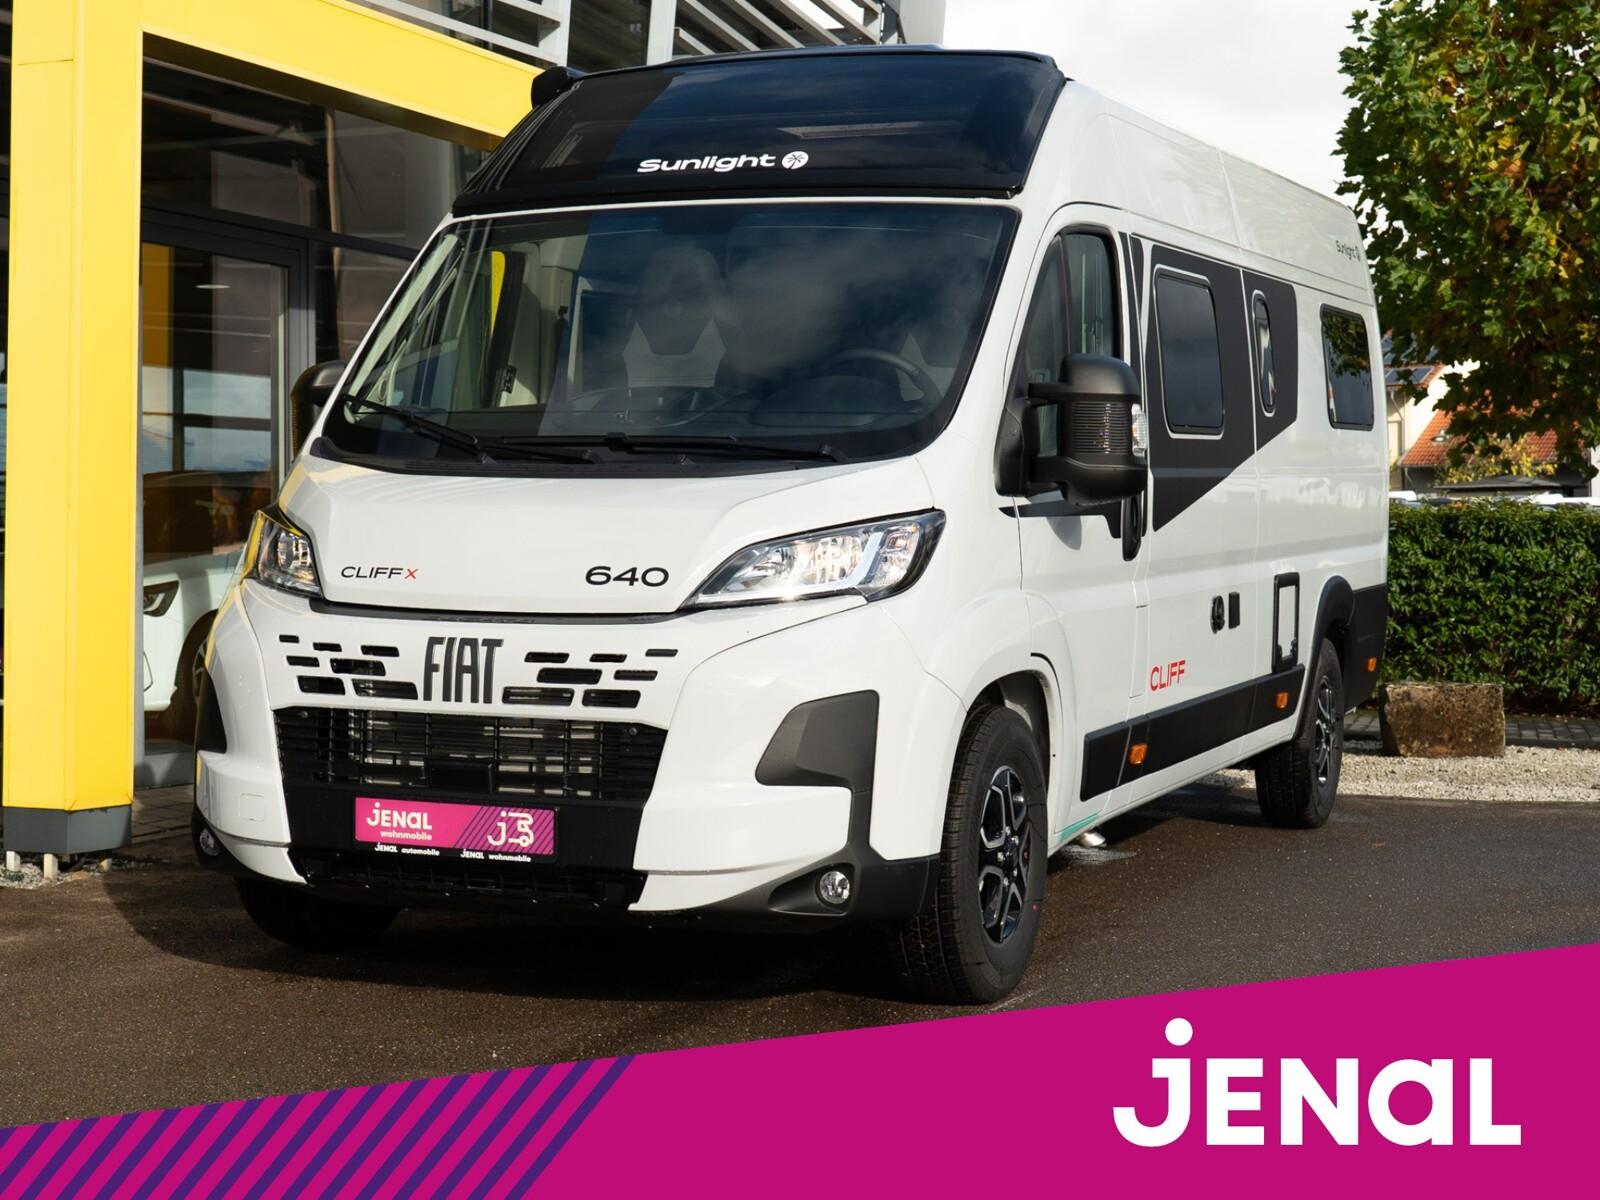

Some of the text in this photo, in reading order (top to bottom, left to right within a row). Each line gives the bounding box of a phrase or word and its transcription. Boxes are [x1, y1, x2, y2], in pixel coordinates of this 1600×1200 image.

[637, 153, 776, 173] Sunlight
[585, 566, 669, 587] 640
[423, 637, 504, 704] FIAT
[1150, 659, 1186, 691] CLIFF
[380, 830, 432, 841] wohnmobile
[400, 848, 440, 857] automobile
[488, 853, 532, 863] wohnmobile
